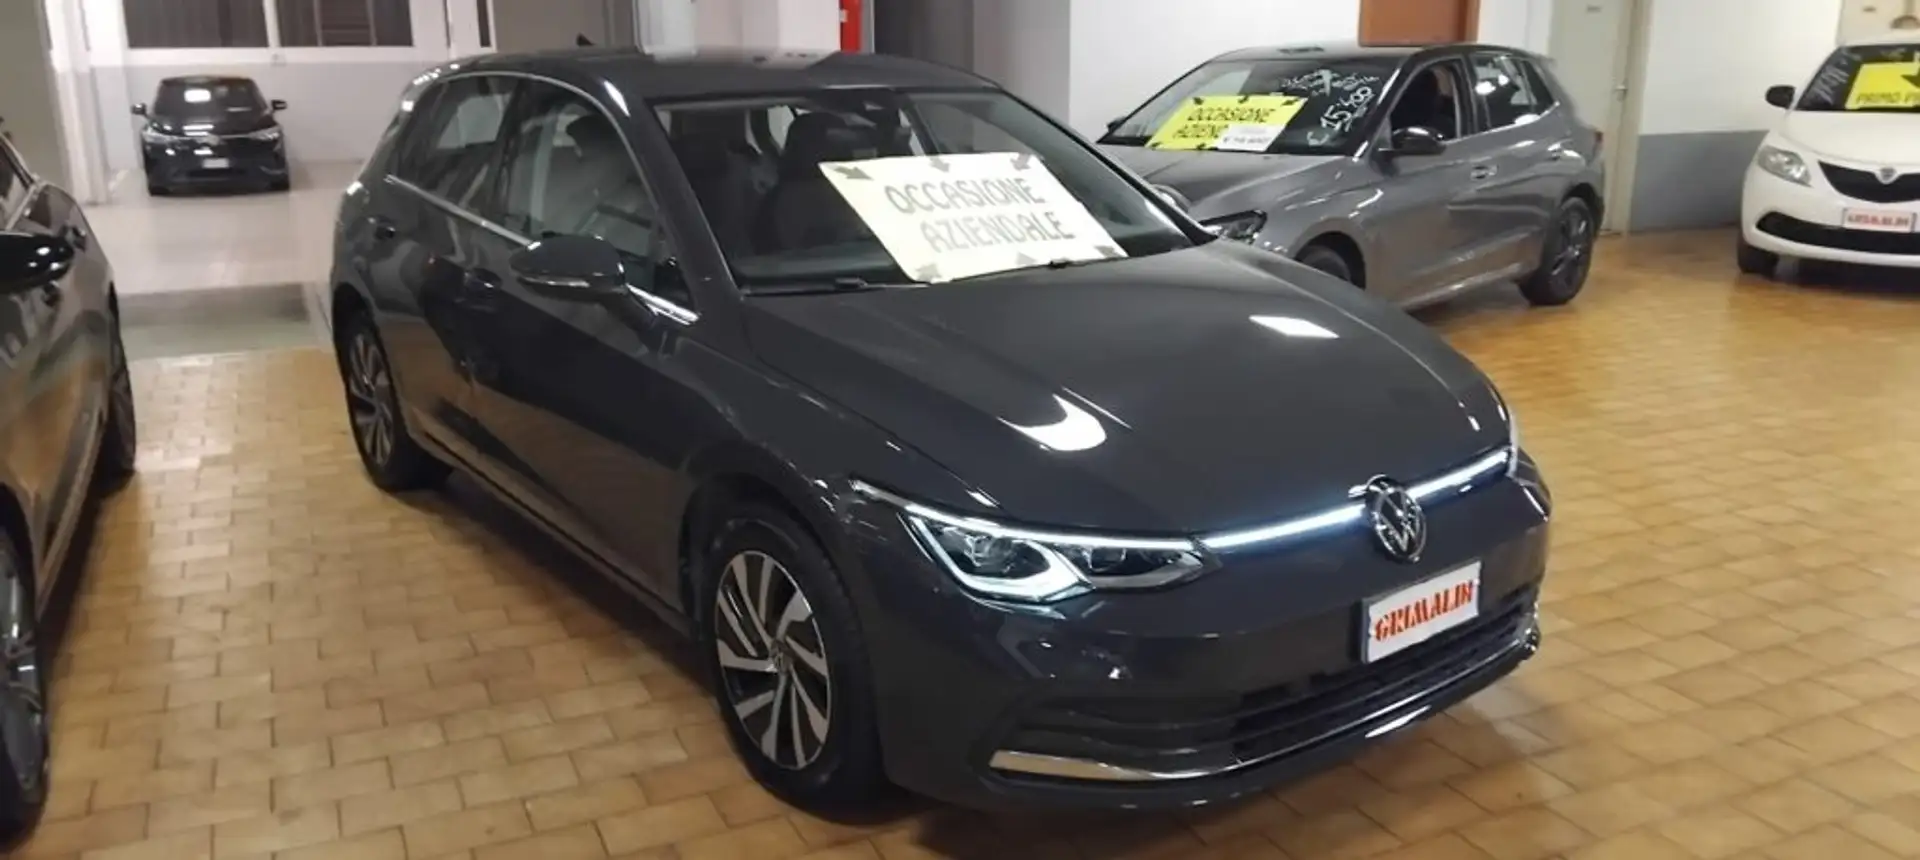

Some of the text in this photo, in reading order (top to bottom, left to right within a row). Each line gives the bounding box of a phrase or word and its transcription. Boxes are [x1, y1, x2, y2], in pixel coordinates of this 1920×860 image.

[1187, 107, 1276, 123] OCCASIONE
[884, 178, 1046, 214] OCCASIONE
[920, 211, 1076, 253] AZIENDALE
